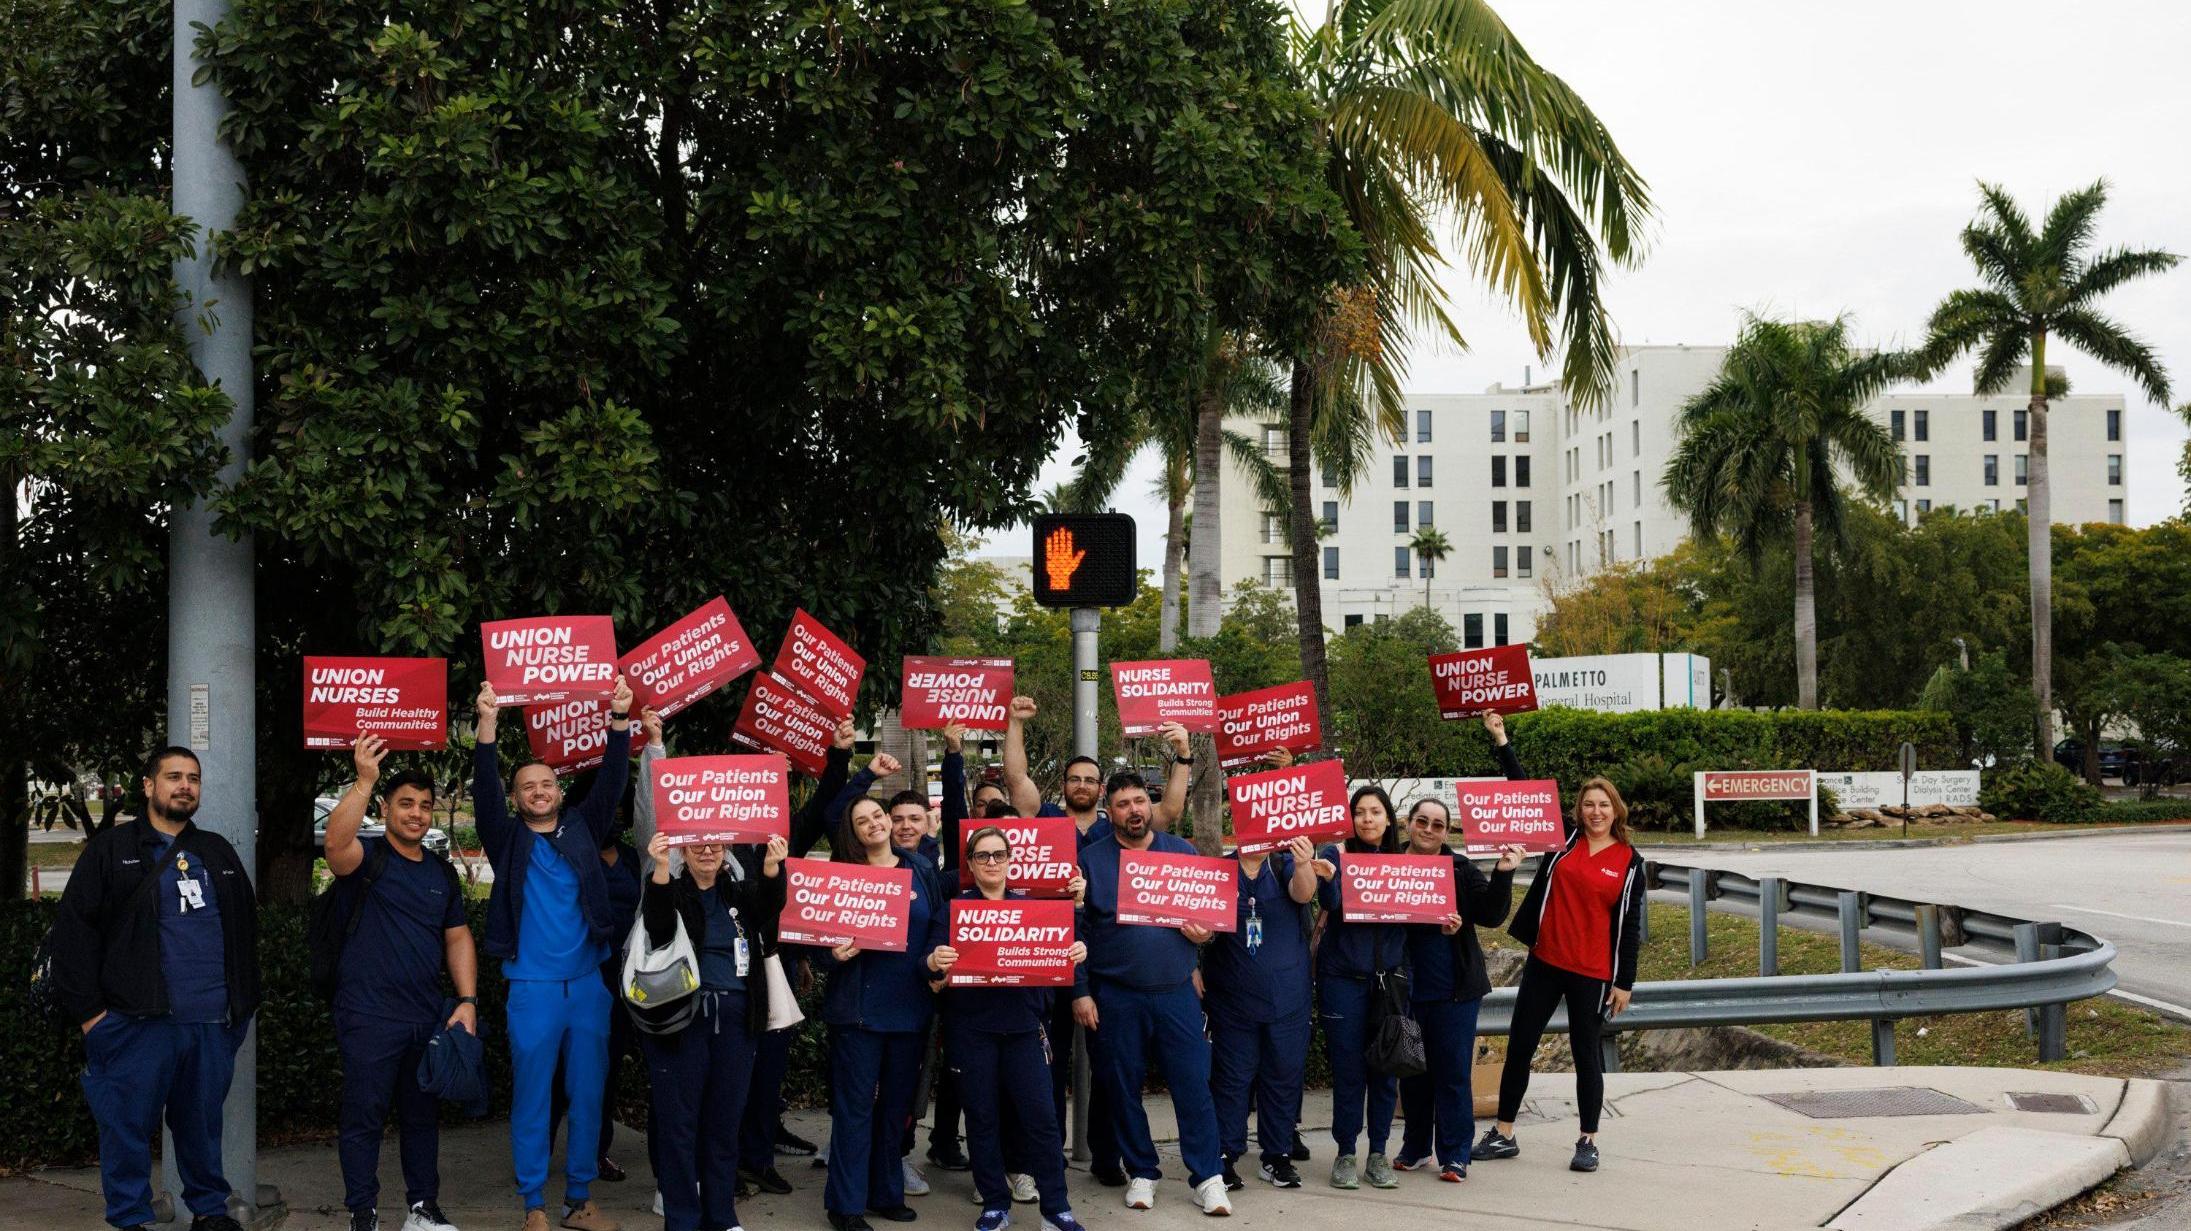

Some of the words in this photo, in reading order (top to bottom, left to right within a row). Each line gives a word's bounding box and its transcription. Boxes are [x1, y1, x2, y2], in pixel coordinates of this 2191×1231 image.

[490, 627, 572, 649] UNION
[630, 652, 658, 677] Our
[661, 613, 726, 658] Patients
[505, 645, 590, 667] NURSE
[642, 661, 671, 686] Our
[674, 633, 721, 666] Union
[794, 624, 817, 645] Our
[816, 640, 858, 680] Patients
[655, 671, 685, 695] Our
[687, 640, 740, 677] Rights
[792, 641, 816, 662] Our
[816, 657, 848, 688] Union
[1435, 657, 1493, 678] UNION
[311, 668, 384, 685] UNION
[523, 663, 614, 685] POWER
[791, 658, 815, 679] Our
[814, 674, 849, 706] Rights
[907, 673, 984, 688] POWER
[1118, 668, 1171, 683] NURSE
[1448, 670, 1509, 691] NURSE
[1535, 670, 1606, 688] PALMETTO
[310, 687, 400, 704] NURSES
[925, 689, 997, 703] NURSE
[1121, 682, 1210, 697] SOLIDARITY
[1461, 682, 1529, 704] POWER
[755, 686, 783, 705] Our
[784, 699, 836, 731] Patients
[1186, 699, 1213, 708] Strong
[1218, 707, 1244, 721] Our
[1247, 694, 1308, 716] Patients
[1585, 691, 1632, 709] Hospital
[355, 708, 388, 718] Build
[391, 708, 439, 719] Healthy
[532, 700, 598, 730] UNION
[755, 702, 783, 721] Our
[784, 714, 823, 740] Union
[938, 704, 1006, 721] UNION
[1160, 708, 1213, 716] Communities
[356, 719, 438, 730] Communities
[1224, 720, 1252, 734] Our
[1256, 711, 1299, 728] Union
[563, 720, 642, 757] POWR
[755, 718, 783, 737] Our
[784, 732, 826, 757] Rights
[1232, 733, 1261, 747] Our
[1264, 722, 1311, 741] Rights
[660, 773, 697, 788] Our
[701, 768, 779, 784] Patients
[1722, 777, 1809, 793] EMERGENCY
[1922, 775, 1938, 786] Day
[1941, 775, 1971, 786] Surgery
[669, 789, 706, 804] Our
[710, 786, 766, 801] Union
[1236, 775, 1306, 803] UNION
[1850, 785, 1880, 796] Building
[1914, 785, 1942, 795] Dialysis
[1946, 785, 1972, 794] Center
[1251, 790, 1323, 818] NURSE
[1463, 793, 1490, 805] Our
[1494, 792, 1552, 805] Patients
[677, 806, 714, 821] Our
[719, 803, 779, 821] Rights
[1266, 804, 1345, 833] POWER
[1471, 807, 1498, 819] Our
[1502, 806, 1543, 818] Union
[1479, 821, 1506, 833] Our
[1510, 820, 1555, 834] Rights
[1010, 845, 1053, 862] RSE
[1007, 862, 1073, 880] OWER
[1126, 862, 1157, 876] Our
[1160, 864, 1230, 882] Patients
[1346, 864, 1377, 876] Our
[1380, 864, 1446, 878] Patients
[790, 872, 824, 887] Our
[827, 876, 902, 896] Patients
[1131, 876, 1163, 889] Our
[1167, 879, 1216, 895] Union
[1353, 877, 1384, 890] Our
[1388, 877, 1435, 890] Union
[795, 889, 830, 904] Our
[834, 893, 887, 911] Union
[1137, 891, 1169, 904] Our
[1172, 894, 1227, 911] Rights
[1360, 891, 1391, 903] Our
[1394, 892, 1447, 906] Rights
[800, 906, 836, 922] Our
[838, 910, 898, 928] Rights
[957, 909, 1023, 925] NURSE
[957, 927, 1070, 942] SOLIDARITY
[997, 947, 1030, 956] Builds
[1033, 947, 1070, 957] Strong
[997, 957, 1067, 967] Communities
